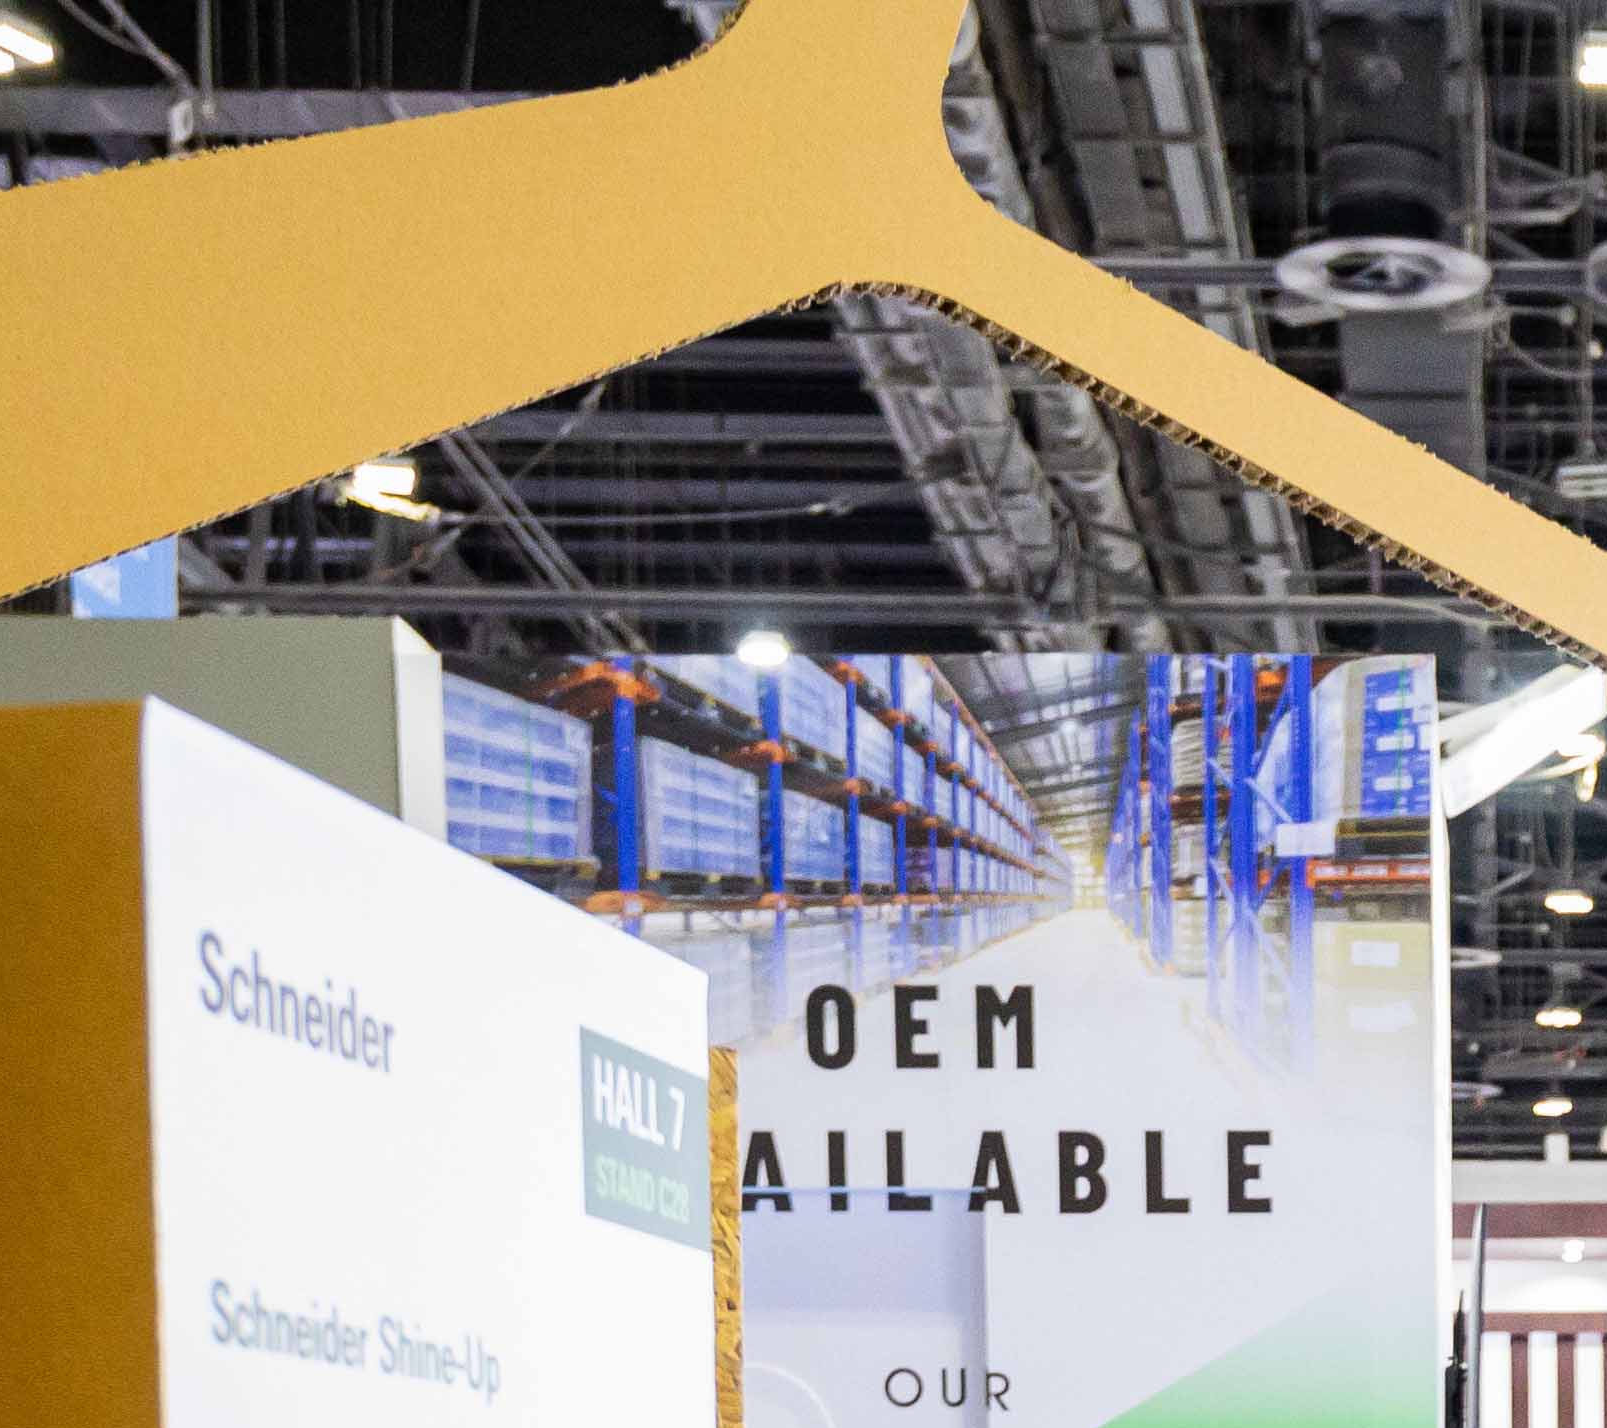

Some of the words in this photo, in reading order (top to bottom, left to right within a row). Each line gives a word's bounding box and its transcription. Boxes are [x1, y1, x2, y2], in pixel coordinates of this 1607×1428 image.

[199, 929, 394, 1073] Schneider
[805, 984, 1036, 1070] OEM
[593, 1055, 665, 1147] HALL
[667, 1086, 686, 1152] 7
[595, 1155, 654, 1213] STAND
[742, 1130, 1272, 1214] AILABLE
[211, 1279, 366, 1368] Schneider
[379, 1316, 502, 1405] Shine-Up
[884, 1367, 1011, 1411] OUR
